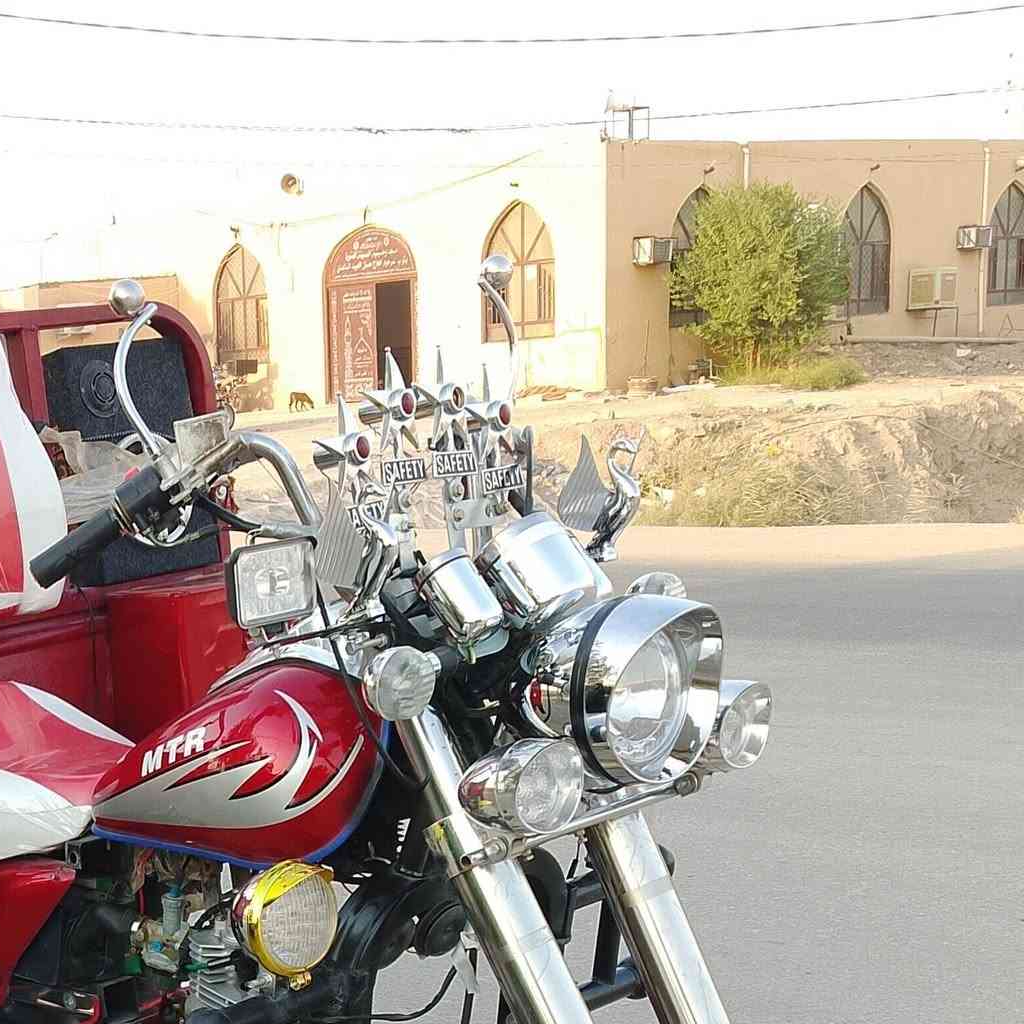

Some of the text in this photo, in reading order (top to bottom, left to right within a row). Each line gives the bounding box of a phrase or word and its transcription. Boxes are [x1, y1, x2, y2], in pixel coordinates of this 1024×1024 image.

[384, 459, 425, 484] SAFETY
[436, 453, 476, 475] SAFETY
[484, 465, 522, 491] SAFETY
[141, 726, 206, 777] MTR
